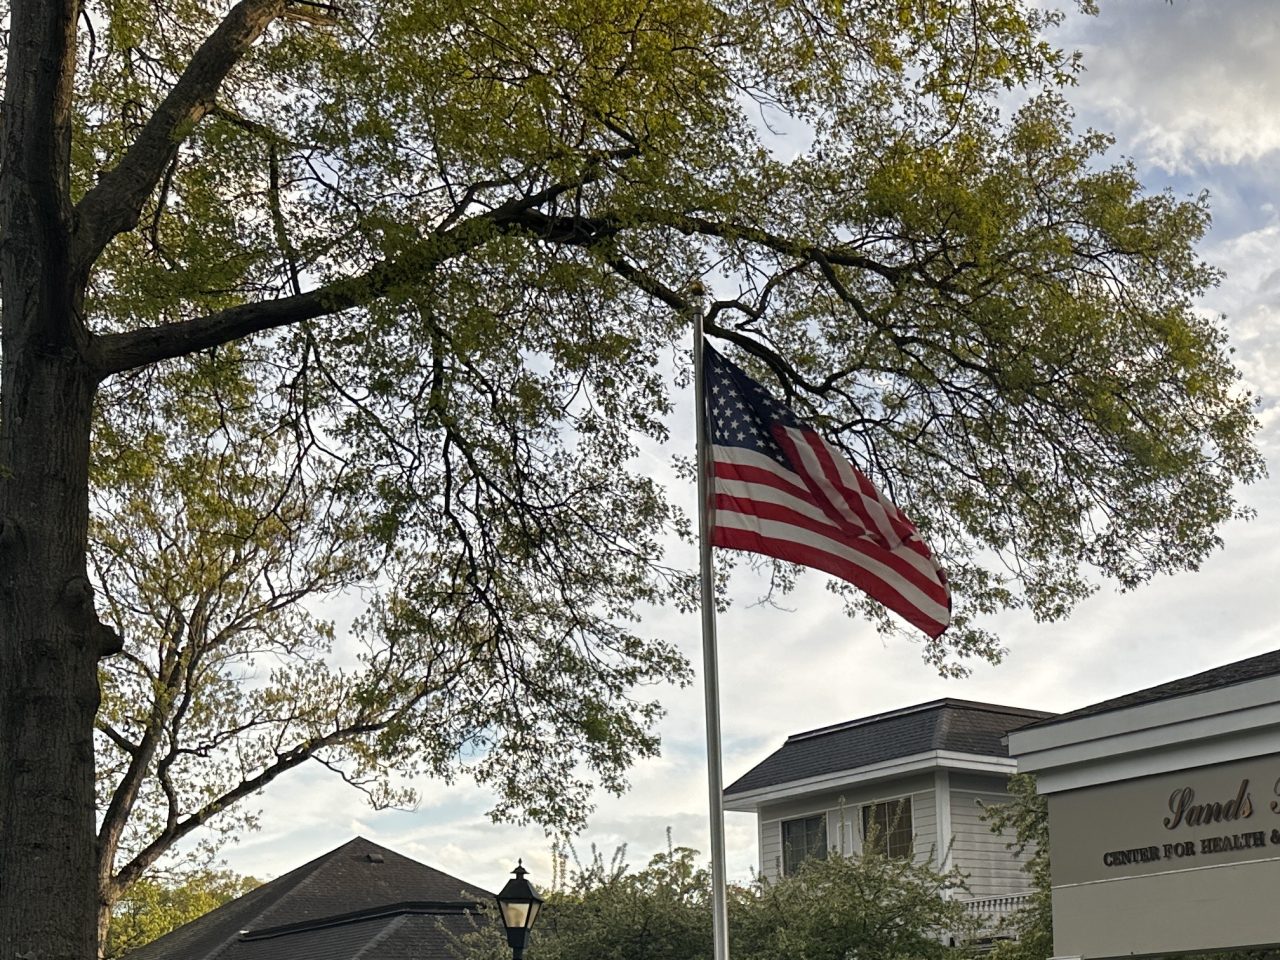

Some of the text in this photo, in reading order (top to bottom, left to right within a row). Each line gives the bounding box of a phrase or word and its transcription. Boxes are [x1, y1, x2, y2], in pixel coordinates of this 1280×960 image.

[1163, 779, 1252, 830] Sands
[1103, 846, 1160, 867] CENTER
[1163, 842, 1196, 859] FOR
[1200, 831, 1266, 854] HEALTH
